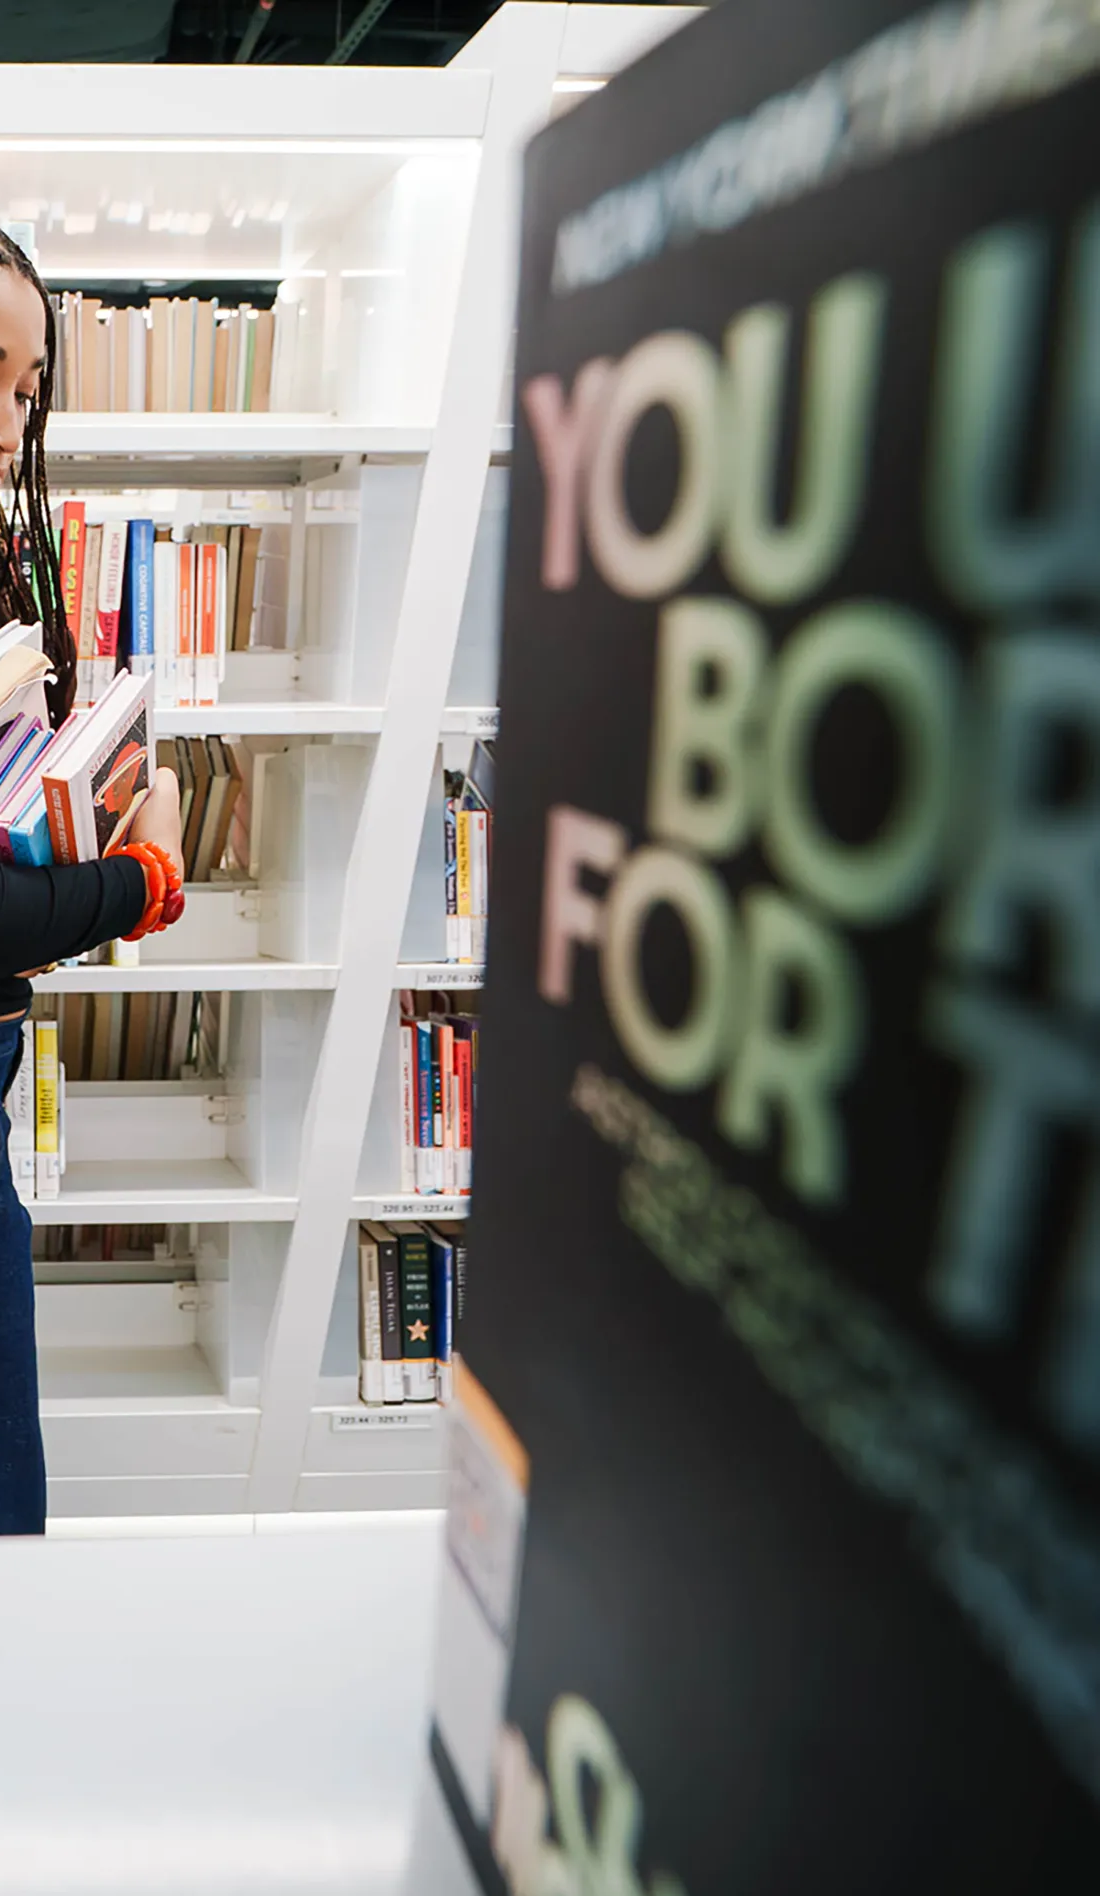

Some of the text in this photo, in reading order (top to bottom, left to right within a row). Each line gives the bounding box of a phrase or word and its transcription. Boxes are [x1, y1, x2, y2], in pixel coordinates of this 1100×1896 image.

[65, 518, 80, 615] RISE
[522, 270, 890, 600] YOU
[537, 800, 860, 1205] FOR
